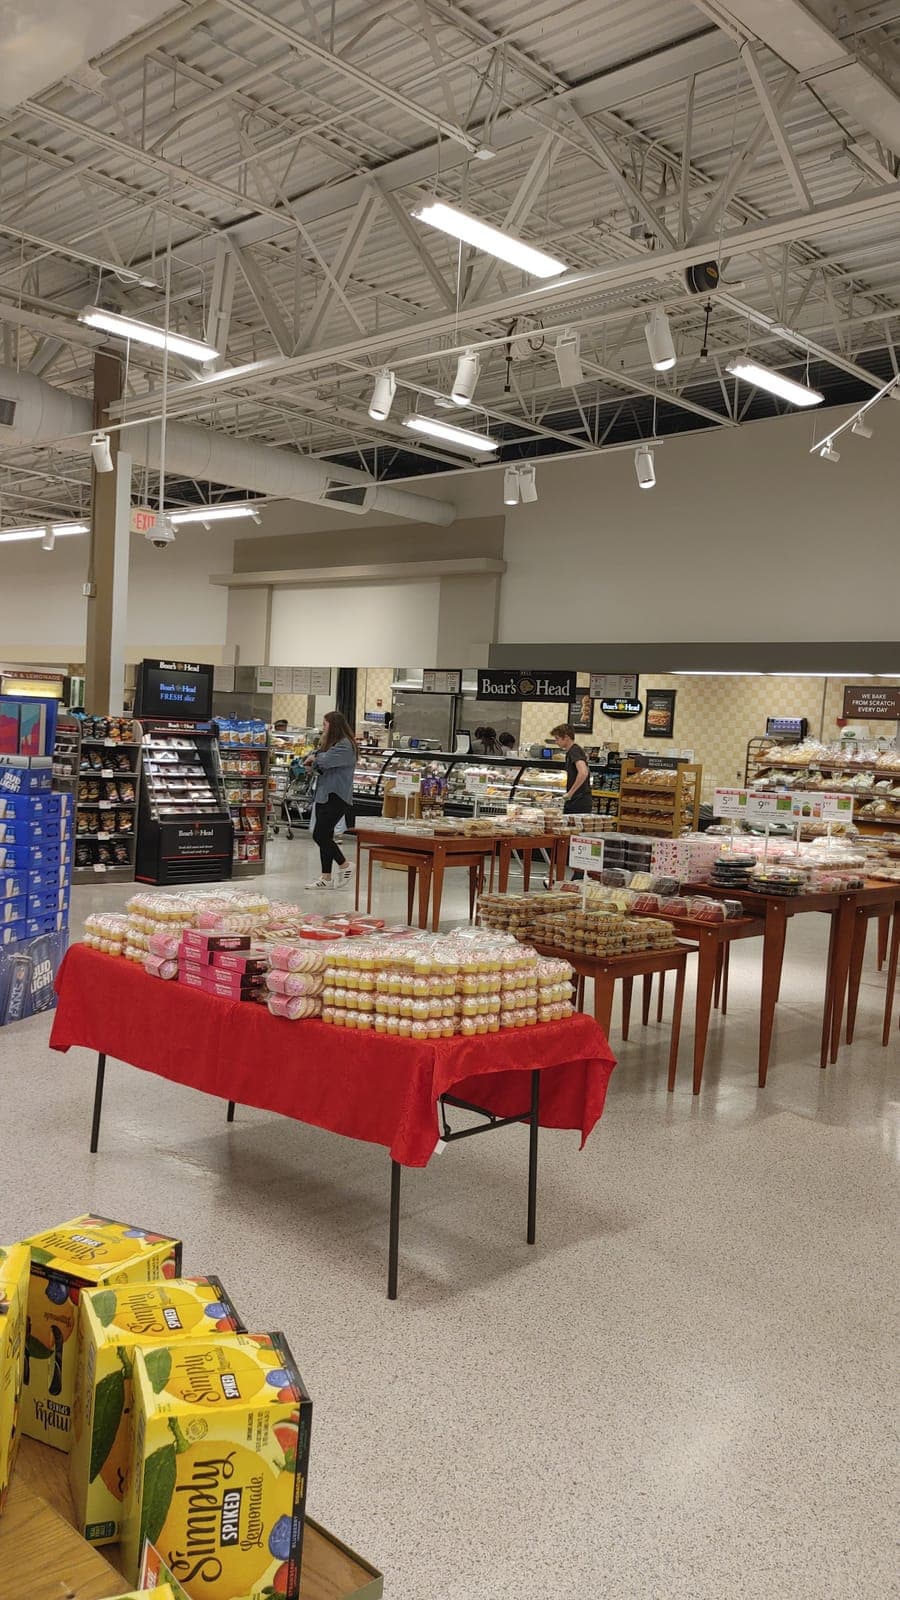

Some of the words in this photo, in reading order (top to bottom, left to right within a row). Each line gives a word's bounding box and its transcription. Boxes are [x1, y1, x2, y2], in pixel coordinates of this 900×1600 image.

[136, 513, 155, 530] EXIT
[160, 693, 183, 701] FRESH
[481, 678, 517, 694] Boar's
[536, 679, 570, 696] Head
[0, 778, 21, 793] LIGHT
[4, 772, 21, 784] BUD
[41, 1232, 108, 1261] Simply
[121, 1292, 165, 1334] Simply
[164, 1308, 181, 1329] SPIKED
[176, 1349, 221, 1403] Simply
[222, 1374, 240, 1399] SPIKED
[168, 1451, 237, 1583] Simply
[222, 1491, 241, 1541] SPIKED
[240, 1476, 264, 1552] Lemonade
